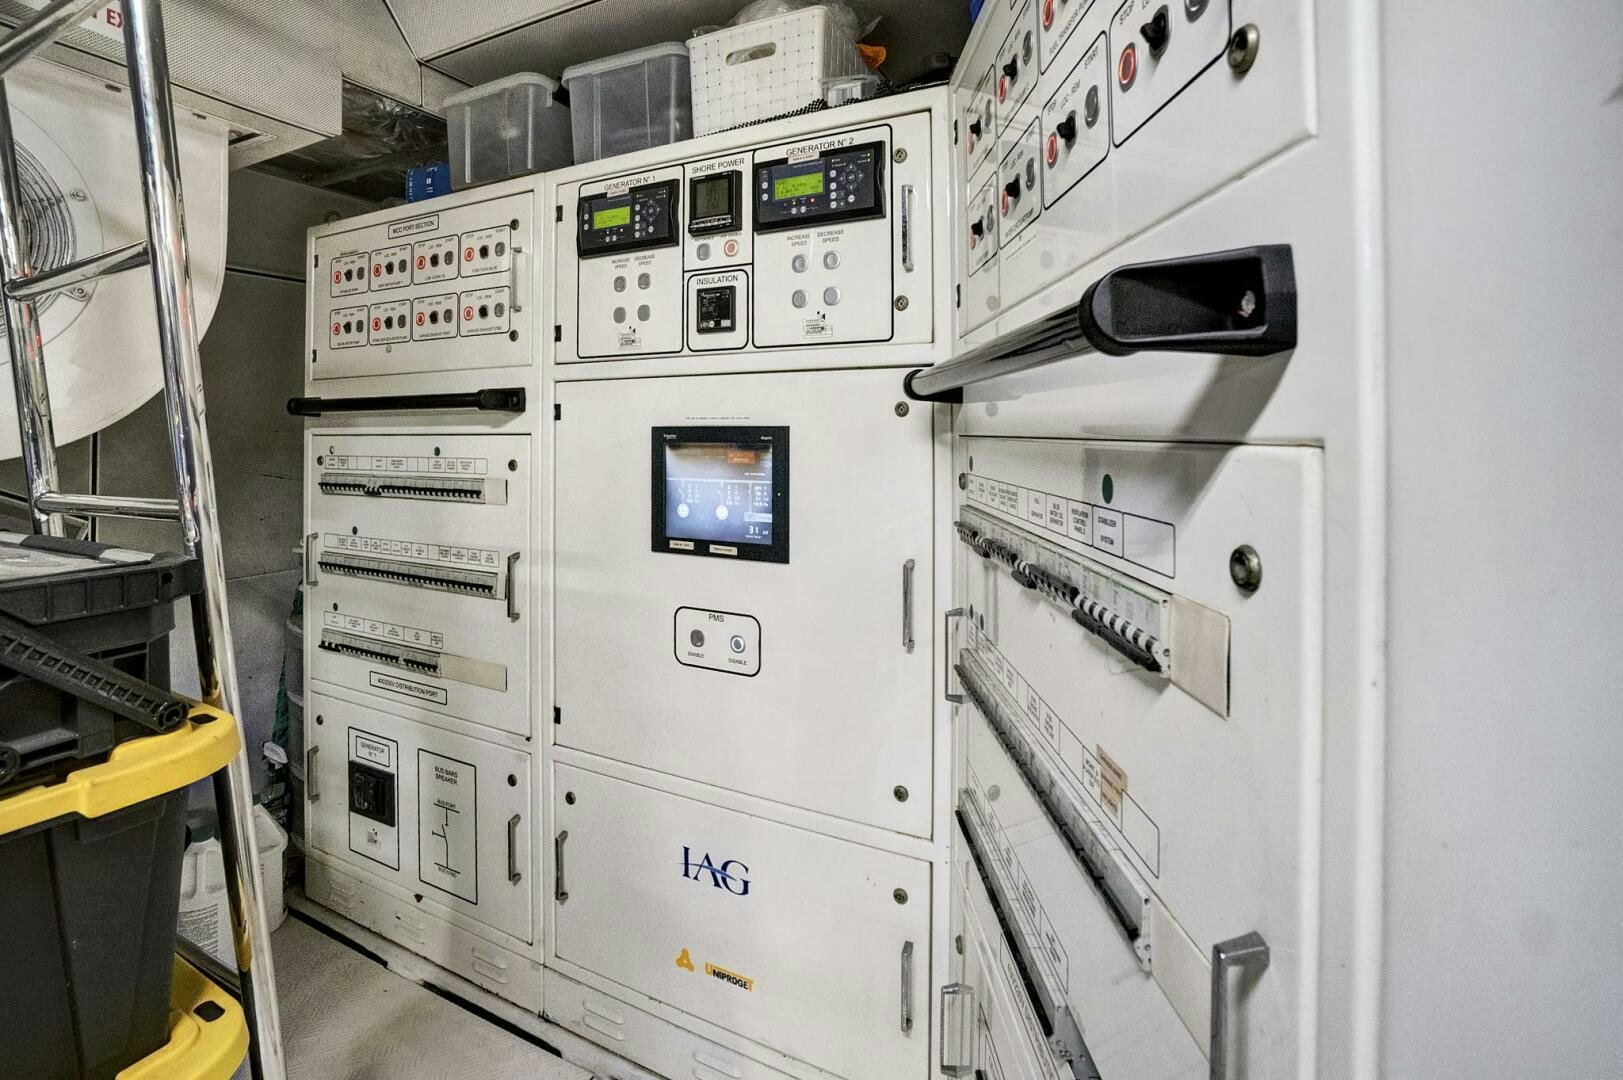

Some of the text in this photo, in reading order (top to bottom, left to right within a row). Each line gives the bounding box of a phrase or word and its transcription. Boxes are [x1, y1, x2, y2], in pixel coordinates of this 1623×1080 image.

[786, 140, 836, 156] GENERATOR
[838, 138, 847, 147] N°
[692, 158, 744, 174] SHORE POWER
[604, 178, 641, 192] GENERATOR
[392, 220, 434, 234] MCC PORT SECTION
[817, 229, 844, 237] DECREASE
[696, 275, 738, 286] INSULATION
[708, 613, 725, 622] PMS
[728, 658, 747, 666] DISABLE
[426, 690, 438, 698] PORT
[435, 766, 458, 779] BUS BARS
[435, 773, 458, 785] BREAKER
[682, 845, 752, 896] IAG
